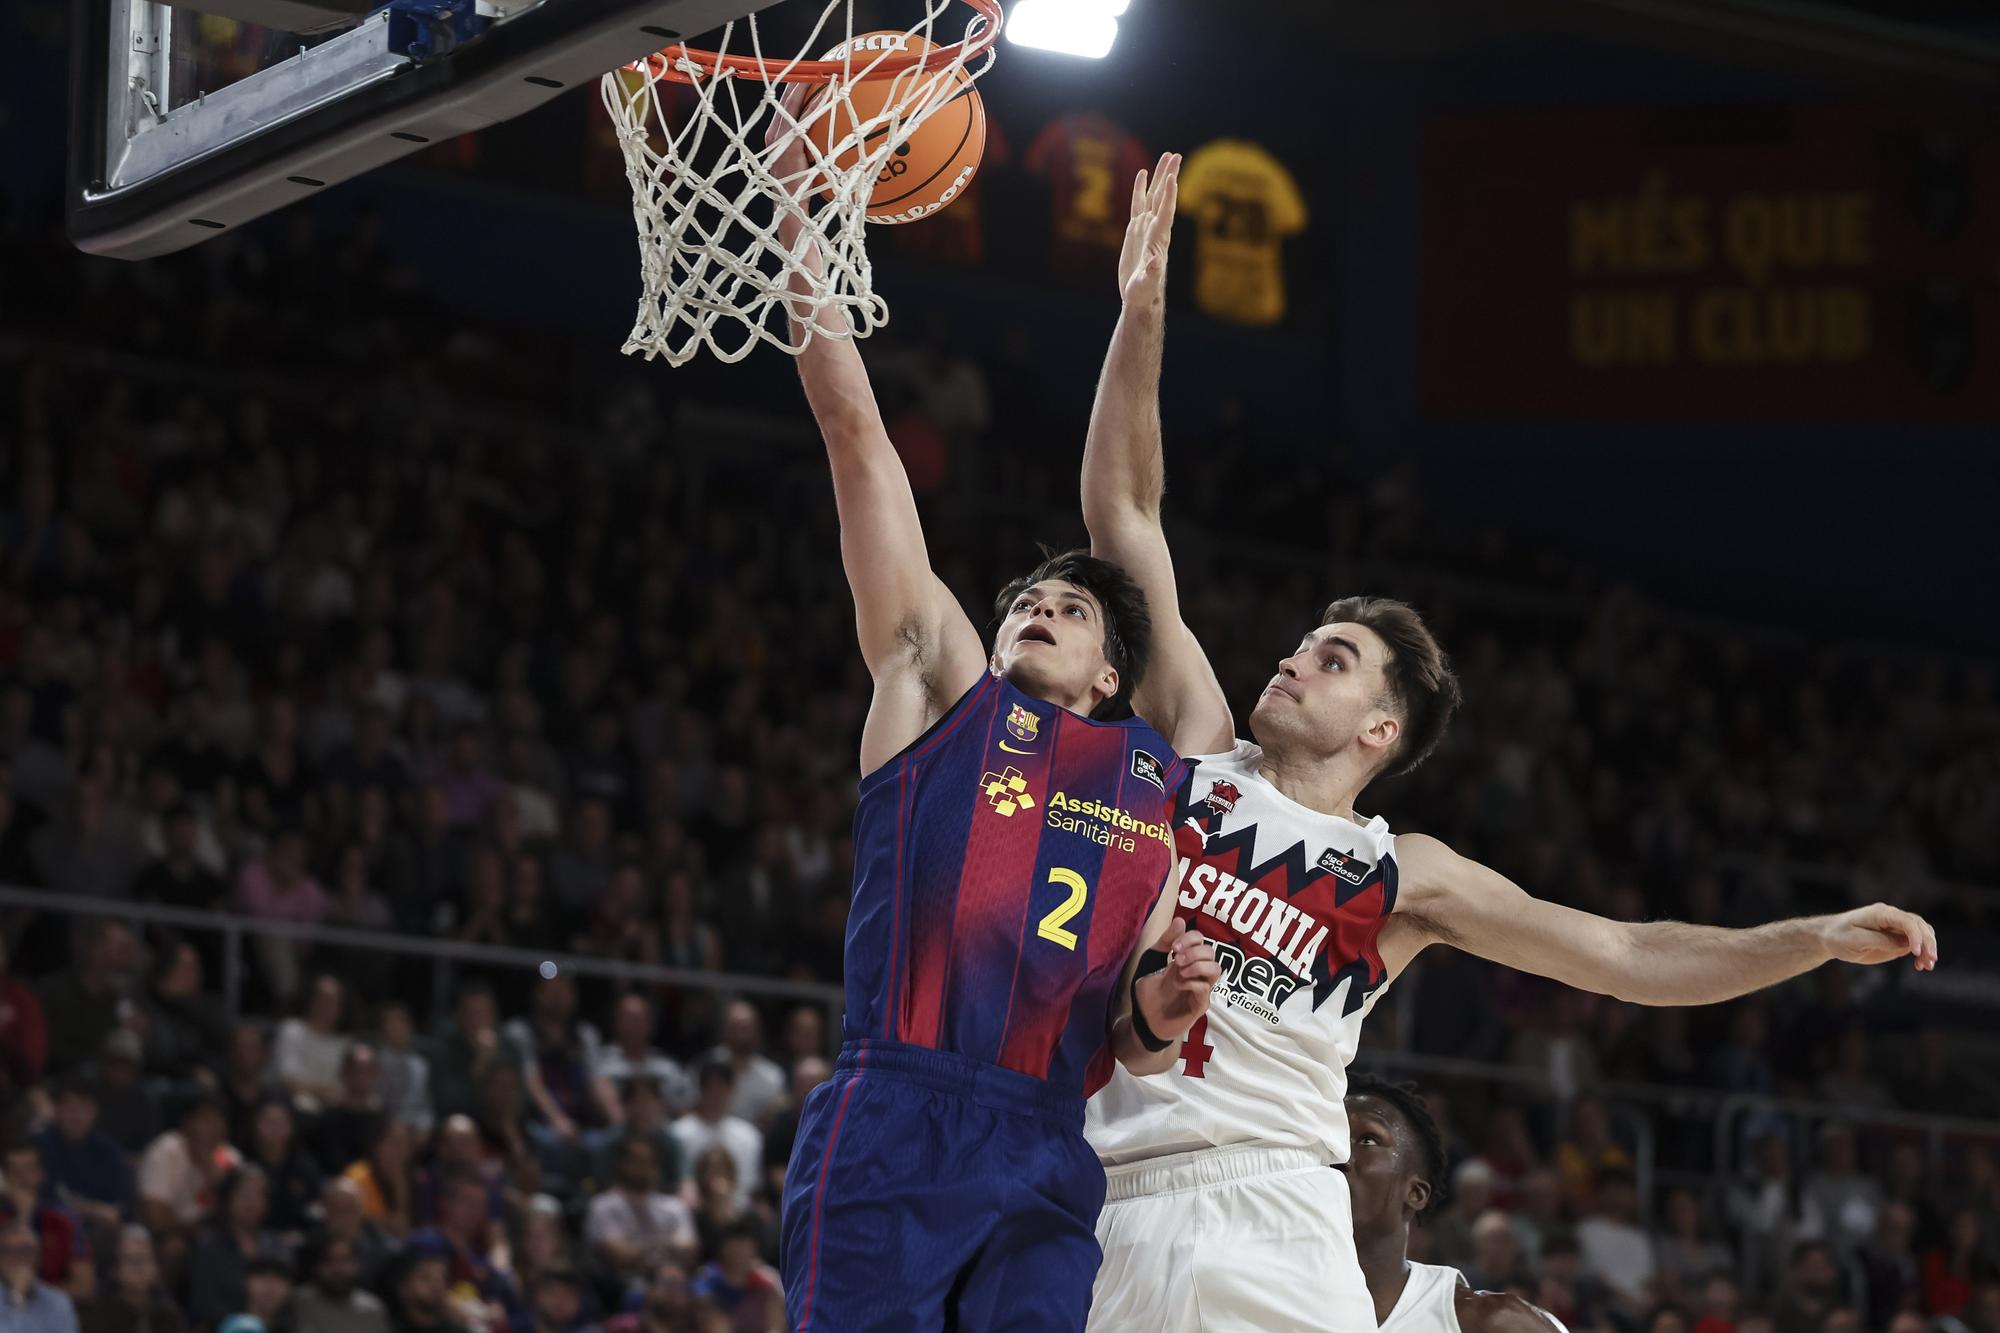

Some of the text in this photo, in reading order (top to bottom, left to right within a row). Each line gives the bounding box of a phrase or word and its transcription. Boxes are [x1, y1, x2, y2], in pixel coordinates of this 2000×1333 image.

[874, 159, 908, 186] cb
[1570, 167, 1871, 288] MÉS QUE
[1570, 288, 1870, 366] UN CLUB
[1137, 757, 1155, 772] liga
[1047, 810, 1135, 853] Sanitària
[1048, 791, 1171, 849] Assistència
[1321, 859, 1360, 882] endesa
[1325, 853, 1344, 866] liga
[1037, 866, 1088, 951] 2
[1178, 857, 1329, 982] SKONIA
[1202, 937, 1295, 1007] ner
[1230, 992, 1280, 1026] eficiente
